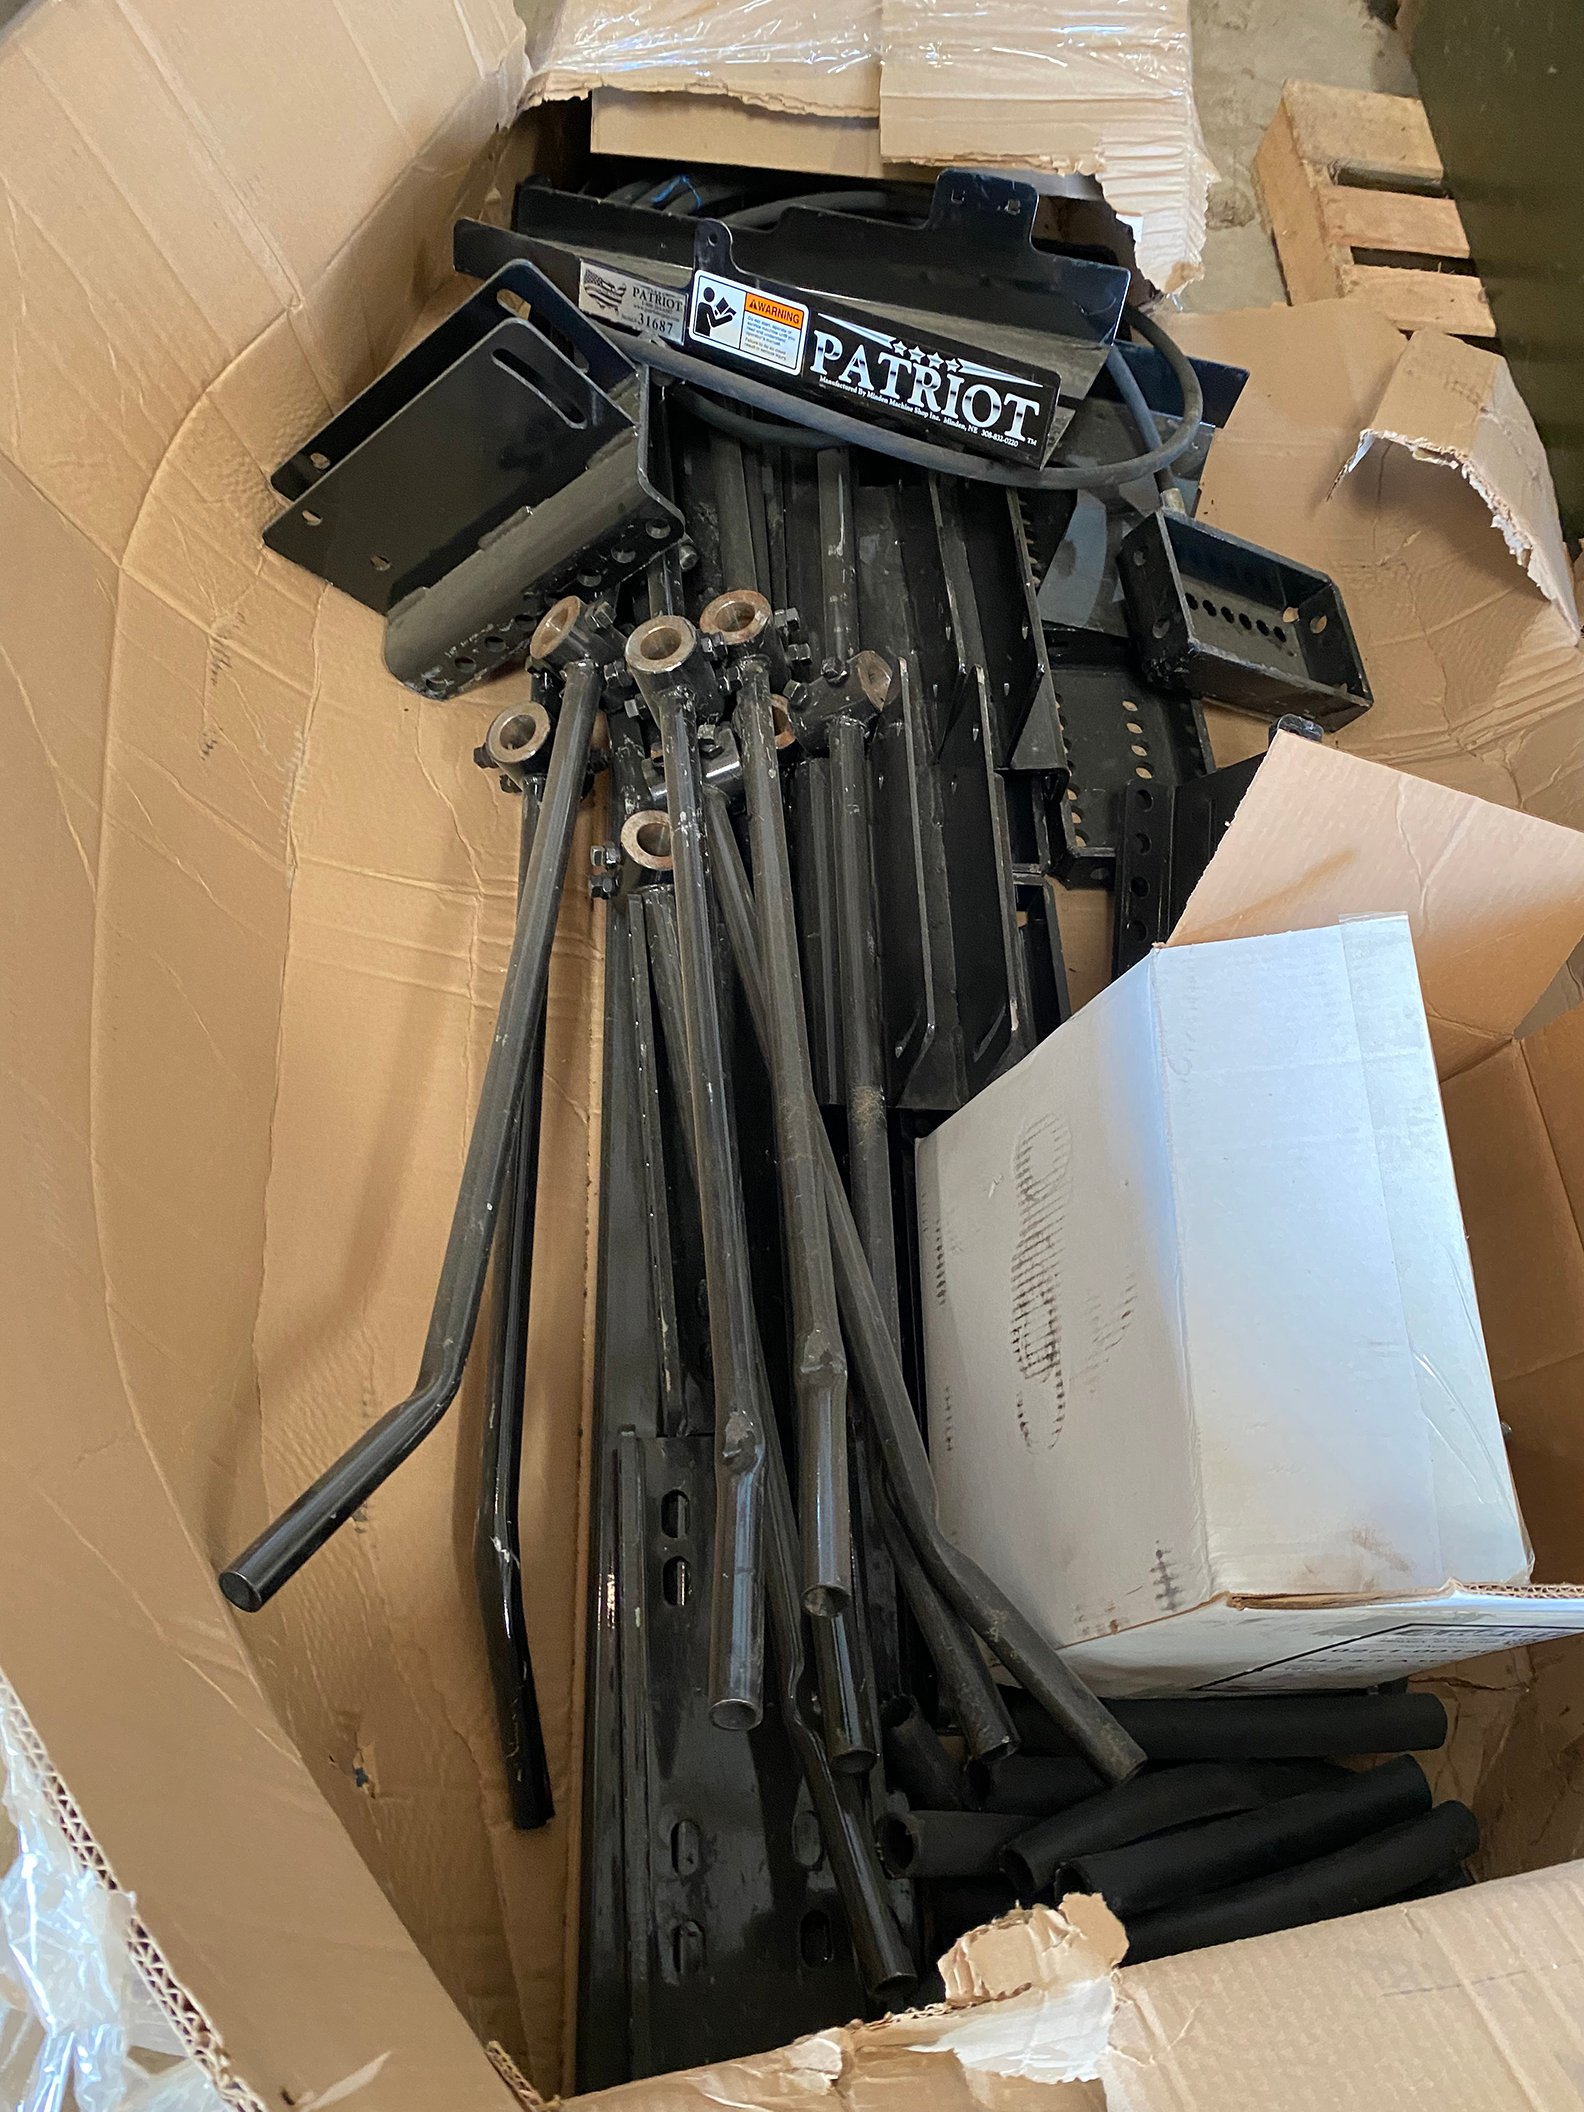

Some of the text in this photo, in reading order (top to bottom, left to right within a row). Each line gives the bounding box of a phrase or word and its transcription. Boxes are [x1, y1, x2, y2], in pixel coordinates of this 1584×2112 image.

[633, 287, 682, 311] PATRIOT
[638, 313, 673, 334] 31687
[758, 302, 799, 323] WARNING
[810, 328, 1041, 443] PATRIOT
[819, 375, 858, 394] Manufactured
[858, 387, 866, 397] By
[867, 391, 888, 404] Minden
[889, 398, 913, 413] Machine
[913, 407, 929, 419] Shop
[929, 412, 941, 421] Inc.
[943, 417, 967, 432] Minden,
[968, 424, 978, 434] NE
